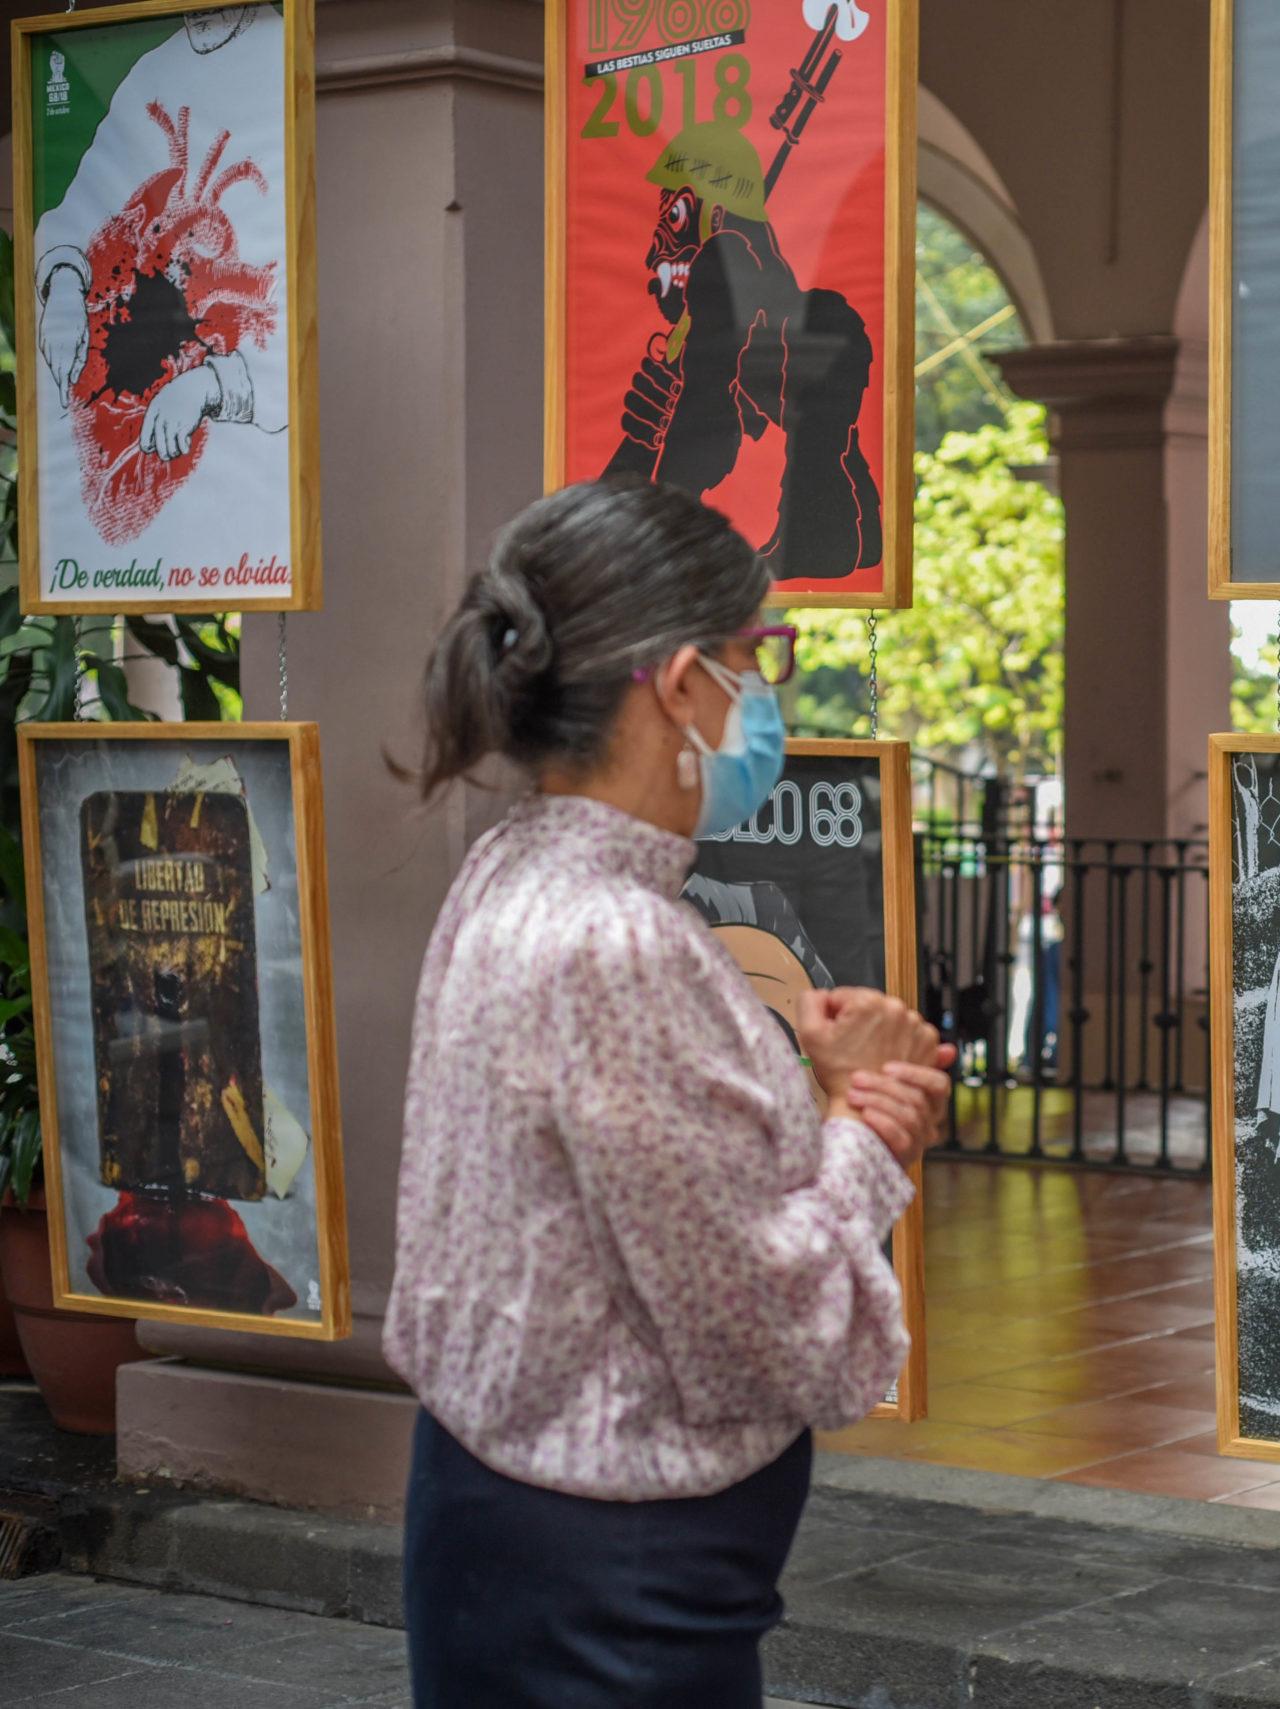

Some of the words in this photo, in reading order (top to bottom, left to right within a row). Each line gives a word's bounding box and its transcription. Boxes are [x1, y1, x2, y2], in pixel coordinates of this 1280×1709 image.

[597, 60, 616, 75] LAS
[616, 52, 654, 71] BESTIAS
[654, 44, 691, 62] SIGUEN
[691, 34, 733, 54] SUELTAS
[580, 53, 753, 139] 2018
[92, 557, 166, 592] verdad,
[167, 565, 196, 588] no
[198, 565, 221, 588] se
[809, 781, 863, 848] 68
[134, 859, 205, 893] LIBERTAD
